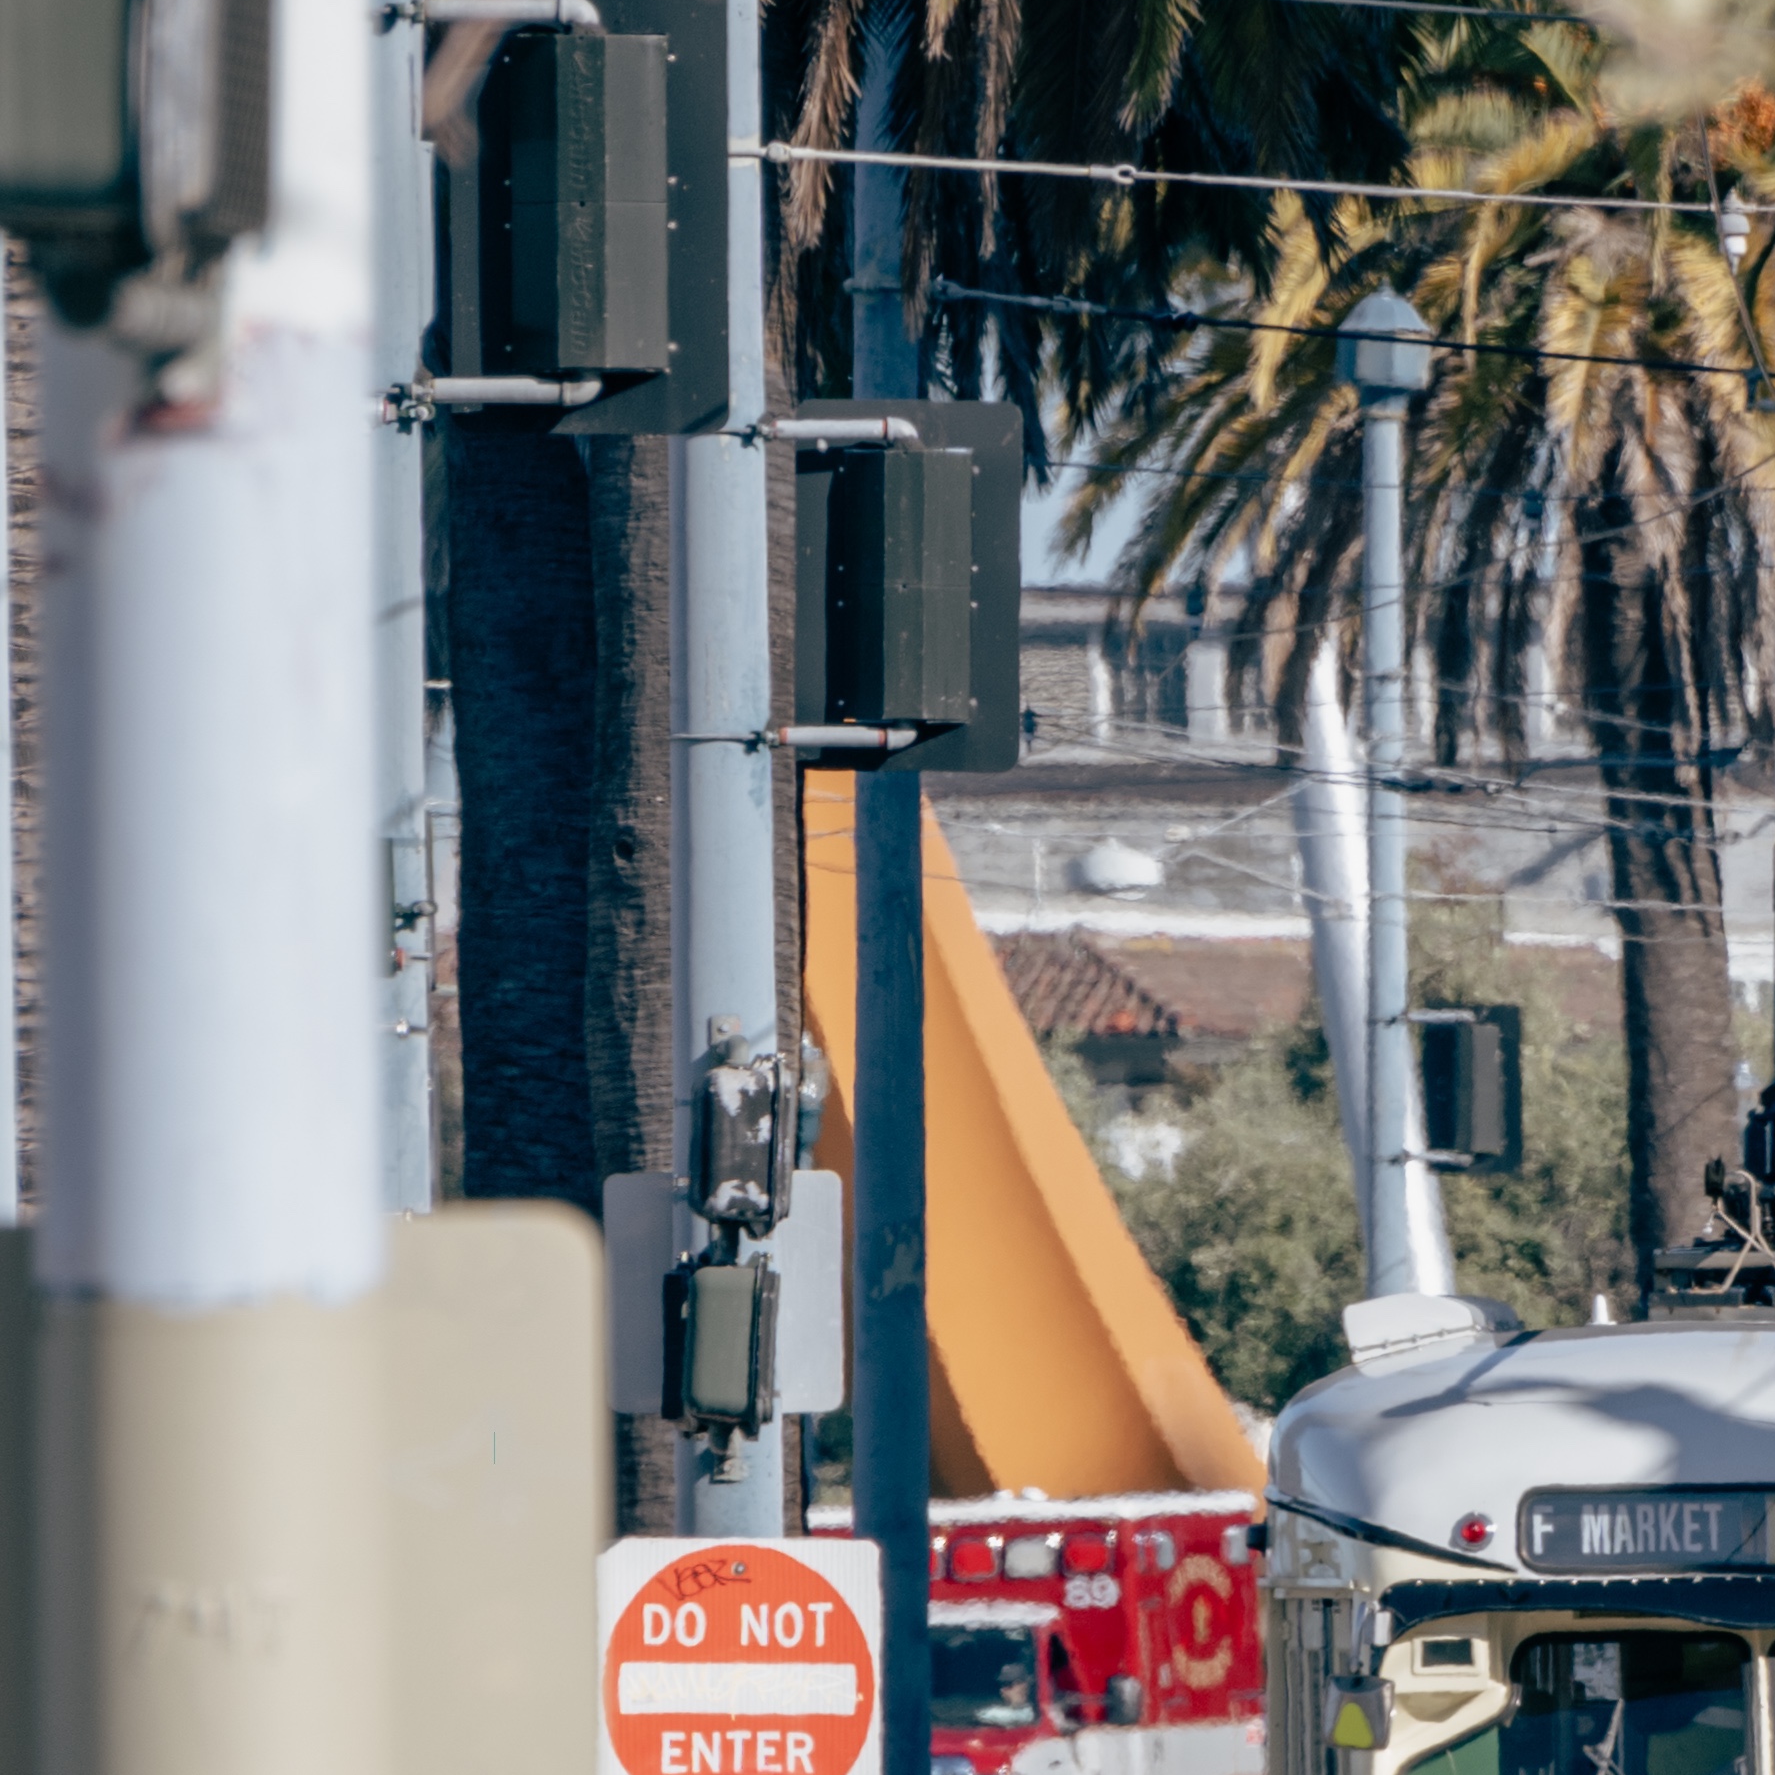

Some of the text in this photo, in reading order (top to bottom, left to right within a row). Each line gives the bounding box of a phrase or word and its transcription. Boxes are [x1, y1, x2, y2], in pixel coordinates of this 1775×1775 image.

[1532, 1502, 1723, 1555] F MARKET
[642, 1601, 834, 1647] DO NOT
[660, 1729, 815, 1774] ENTER
